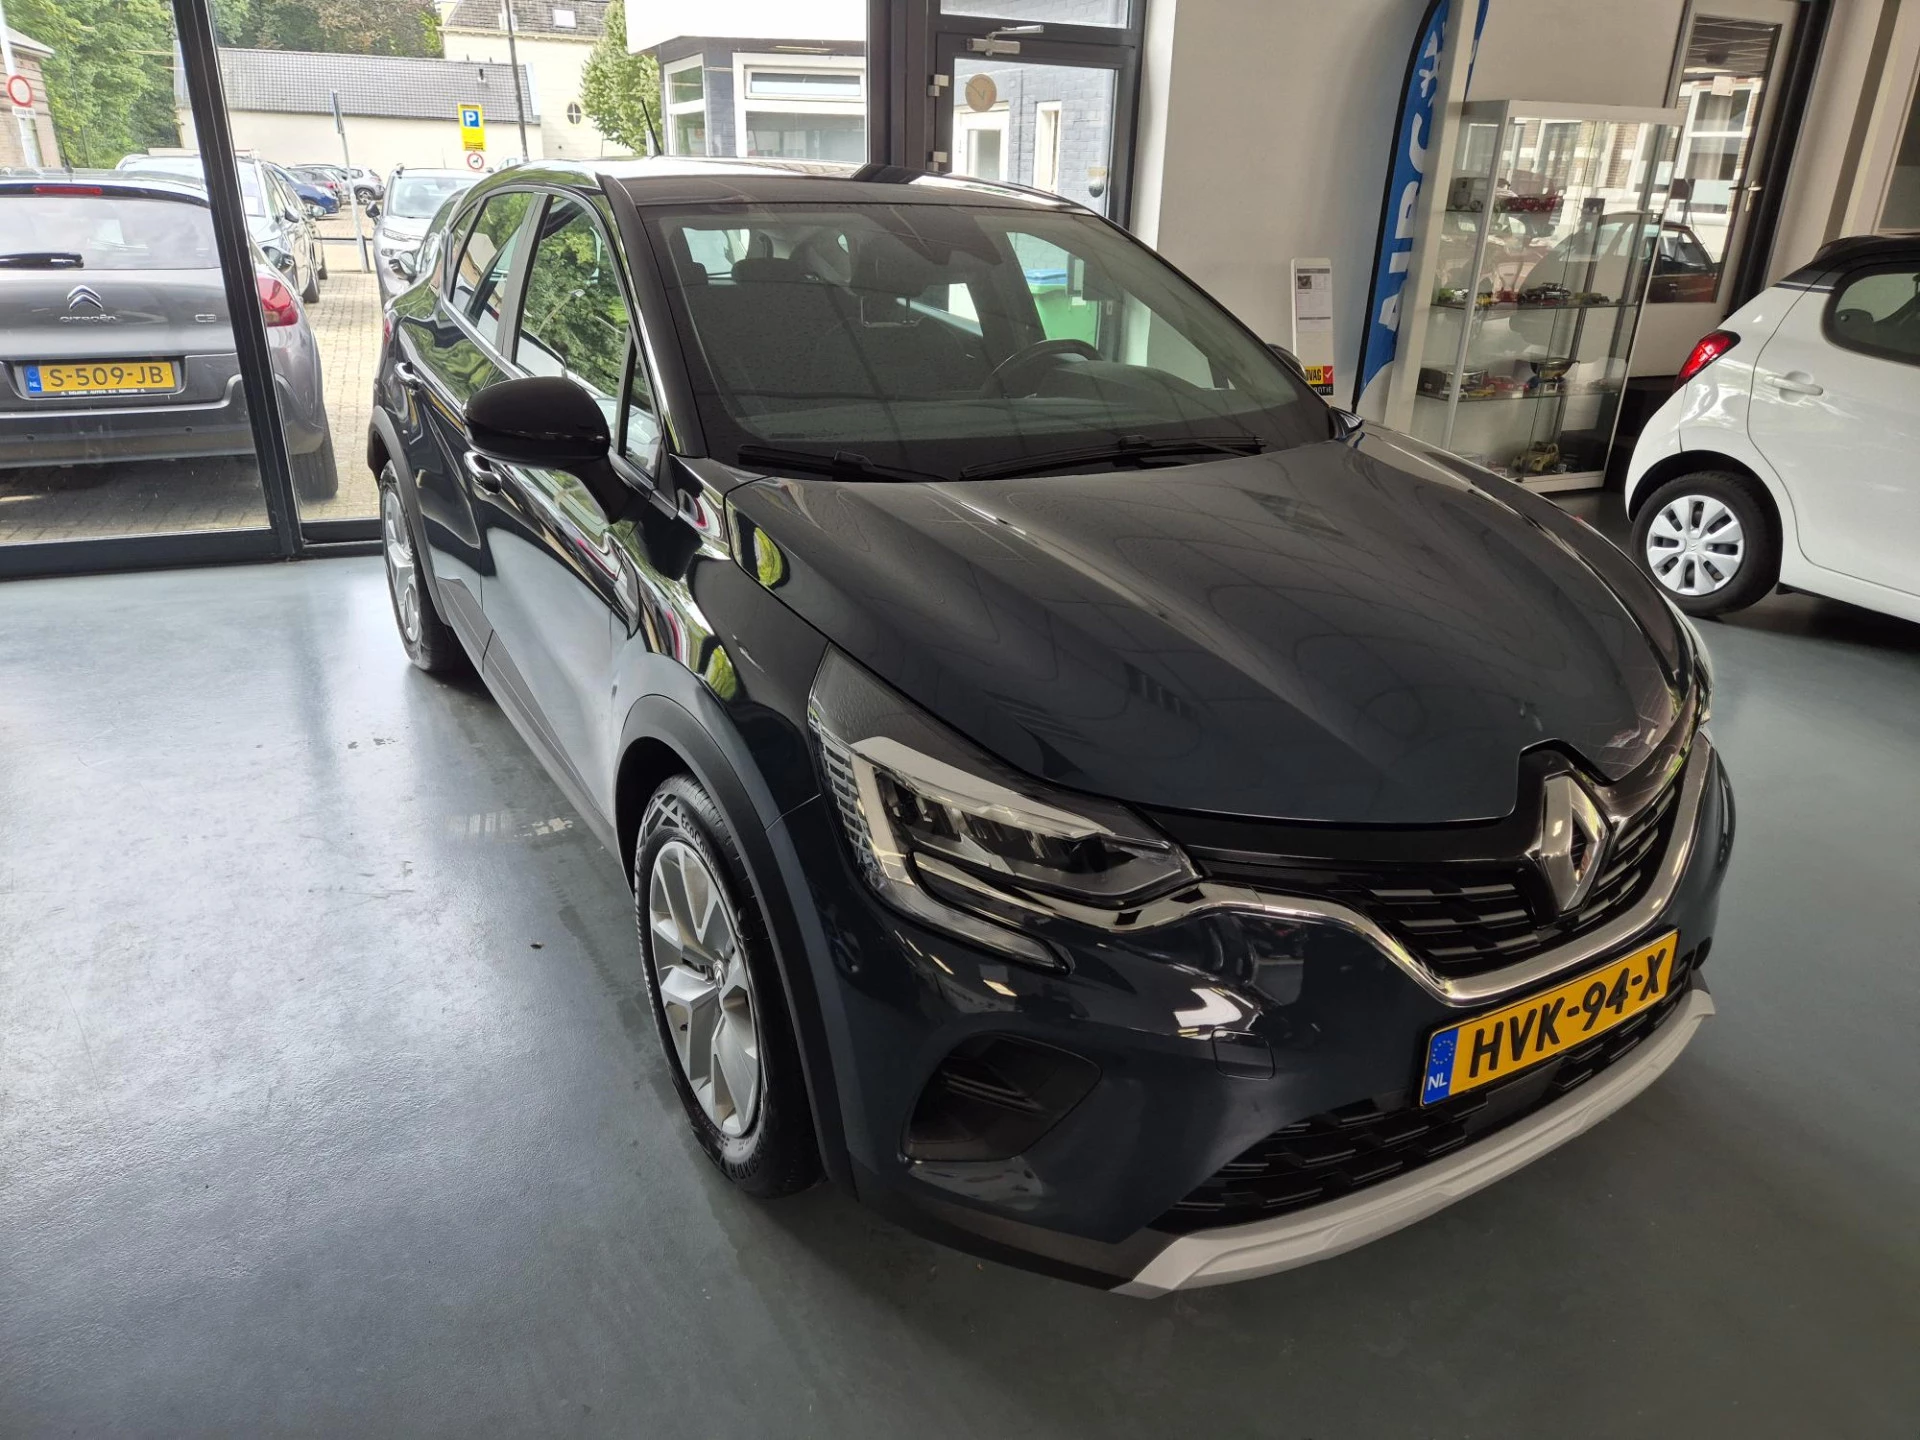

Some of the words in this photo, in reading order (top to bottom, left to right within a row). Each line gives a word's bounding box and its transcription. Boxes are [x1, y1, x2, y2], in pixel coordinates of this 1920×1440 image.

[465, 111, 476, 127] P
[195, 314, 216, 322] C3
[50, 366, 164, 388] S-509-JB
[1468, 947, 1667, 1079] HVK-94-X
[1427, 1074, 1448, 1091] NL
